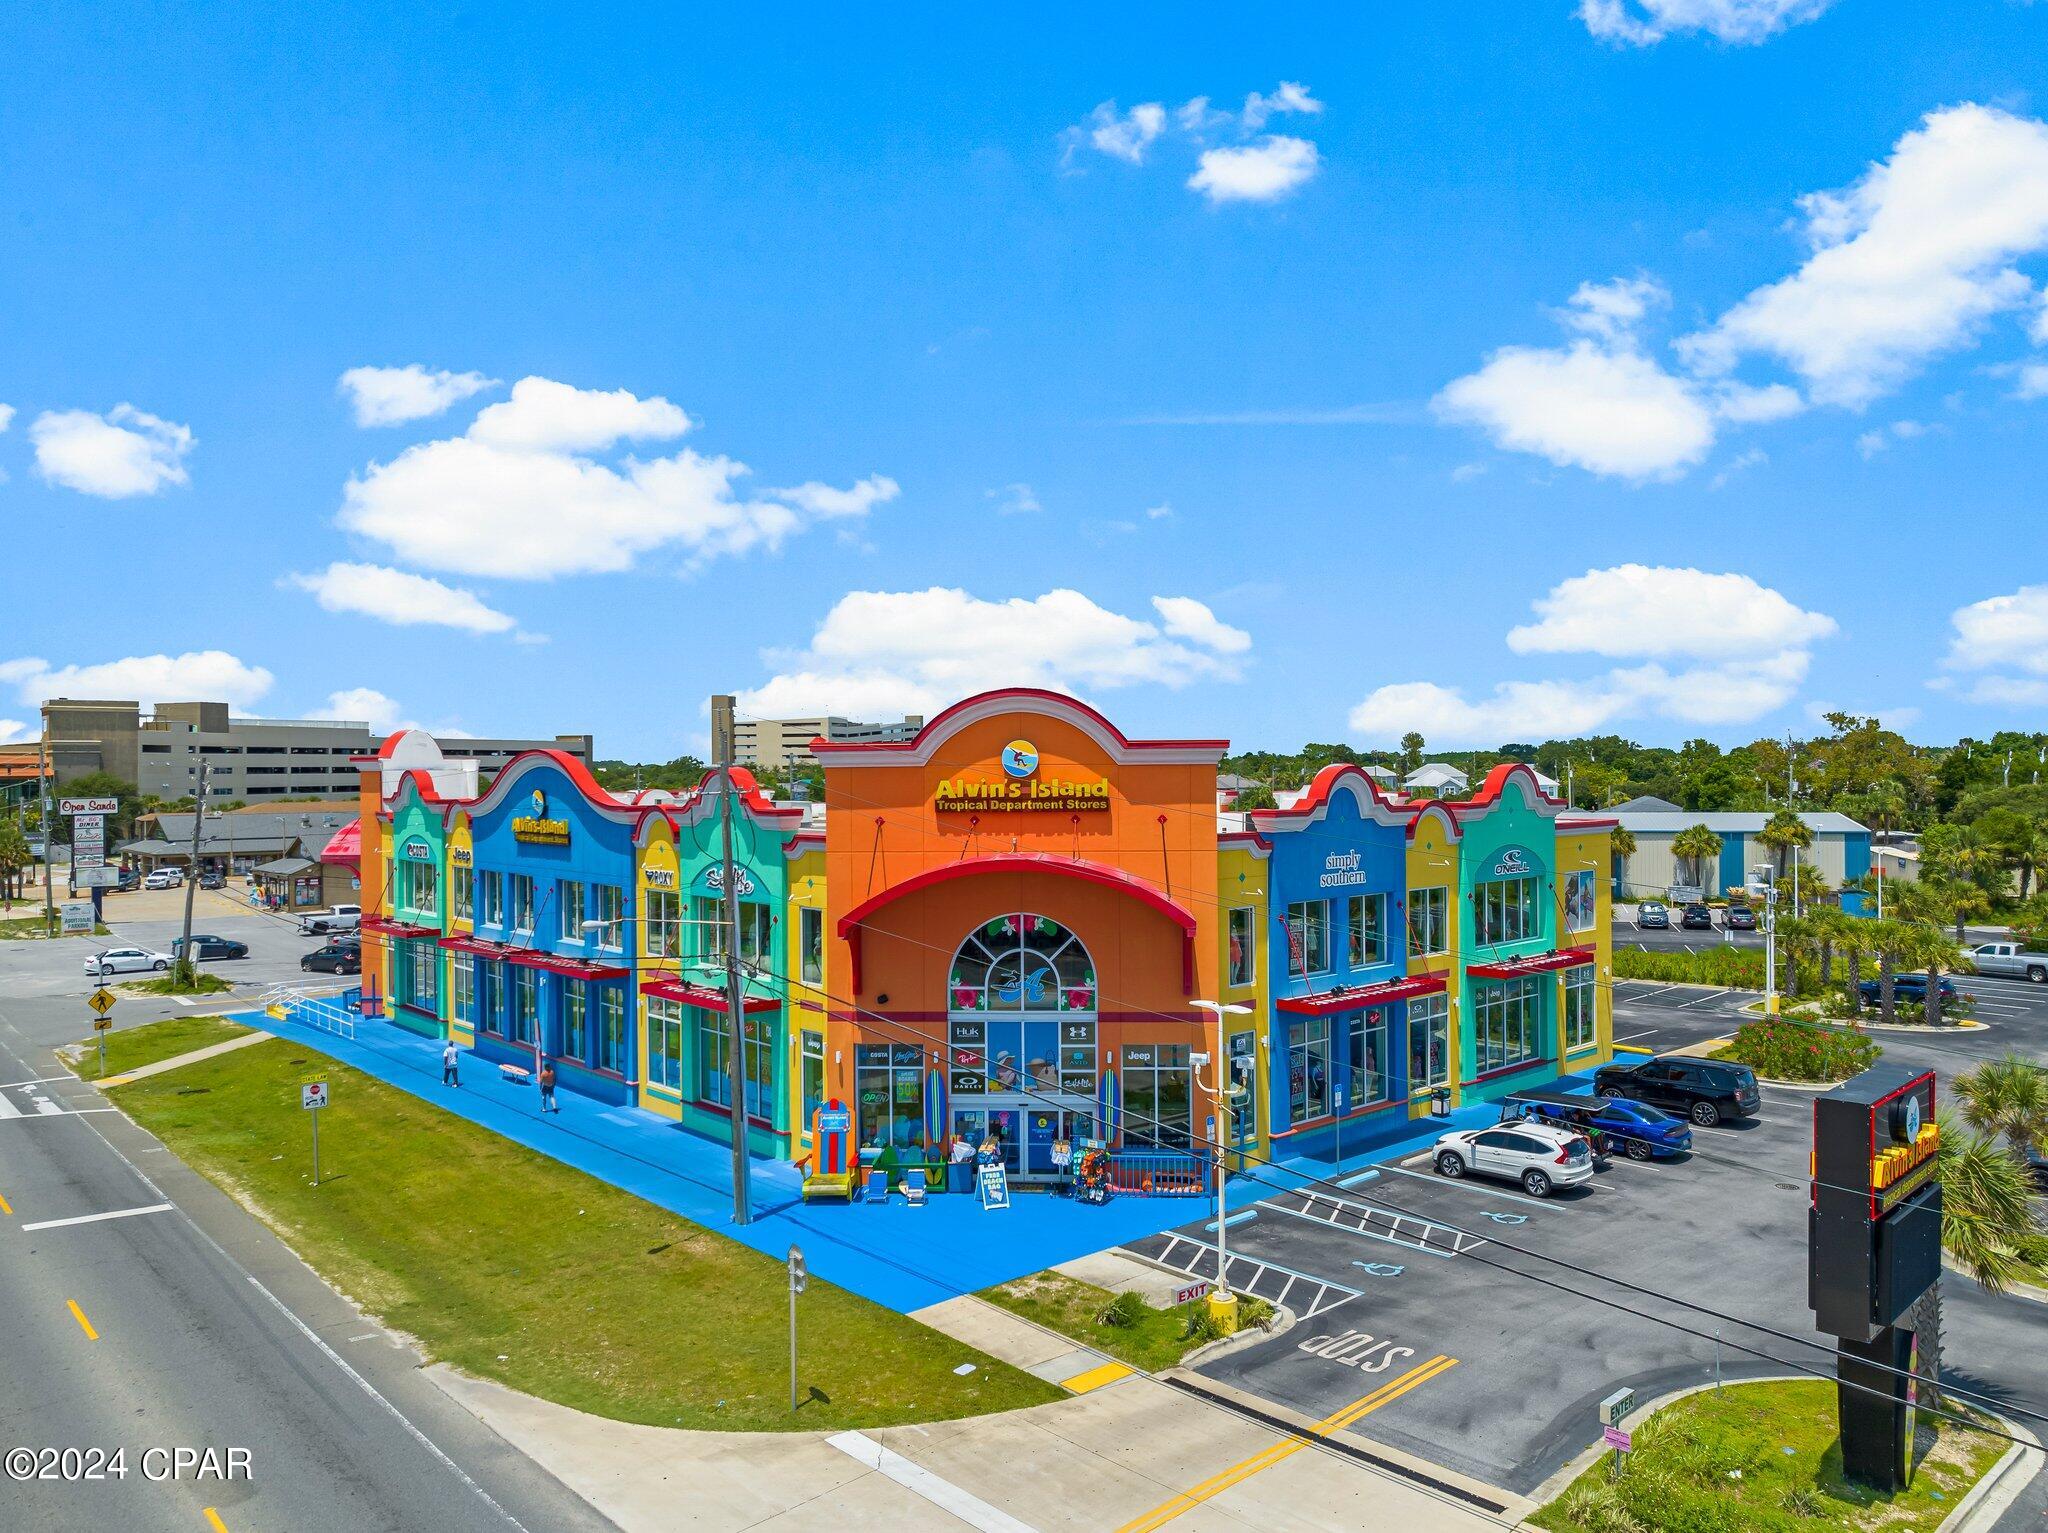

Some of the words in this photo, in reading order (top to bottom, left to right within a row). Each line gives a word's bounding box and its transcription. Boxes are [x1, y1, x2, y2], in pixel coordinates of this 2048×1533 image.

[935, 778, 1021, 800] Alvin's
[1030, 778, 1108, 799] Island
[62, 801, 85, 813] Open
[89, 800, 116, 811] Sands
[937, 800, 987, 811] Tropical
[991, 800, 1063, 811] Department
[1066, 800, 1107, 809] Stores
[453, 847, 471, 862] Jeep
[1326, 849, 1361, 870] simply
[651, 870, 674, 886] ROXY
[1320, 870, 1366, 887] southern
[1128, 1051, 1151, 1061] Jeep
[863, 1093, 888, 1102] OPEN
[1179, 1283, 1207, 1303] EXIT
[1298, 1329, 1415, 1373] STOP
[1610, 1394, 1633, 1420] ENTER
